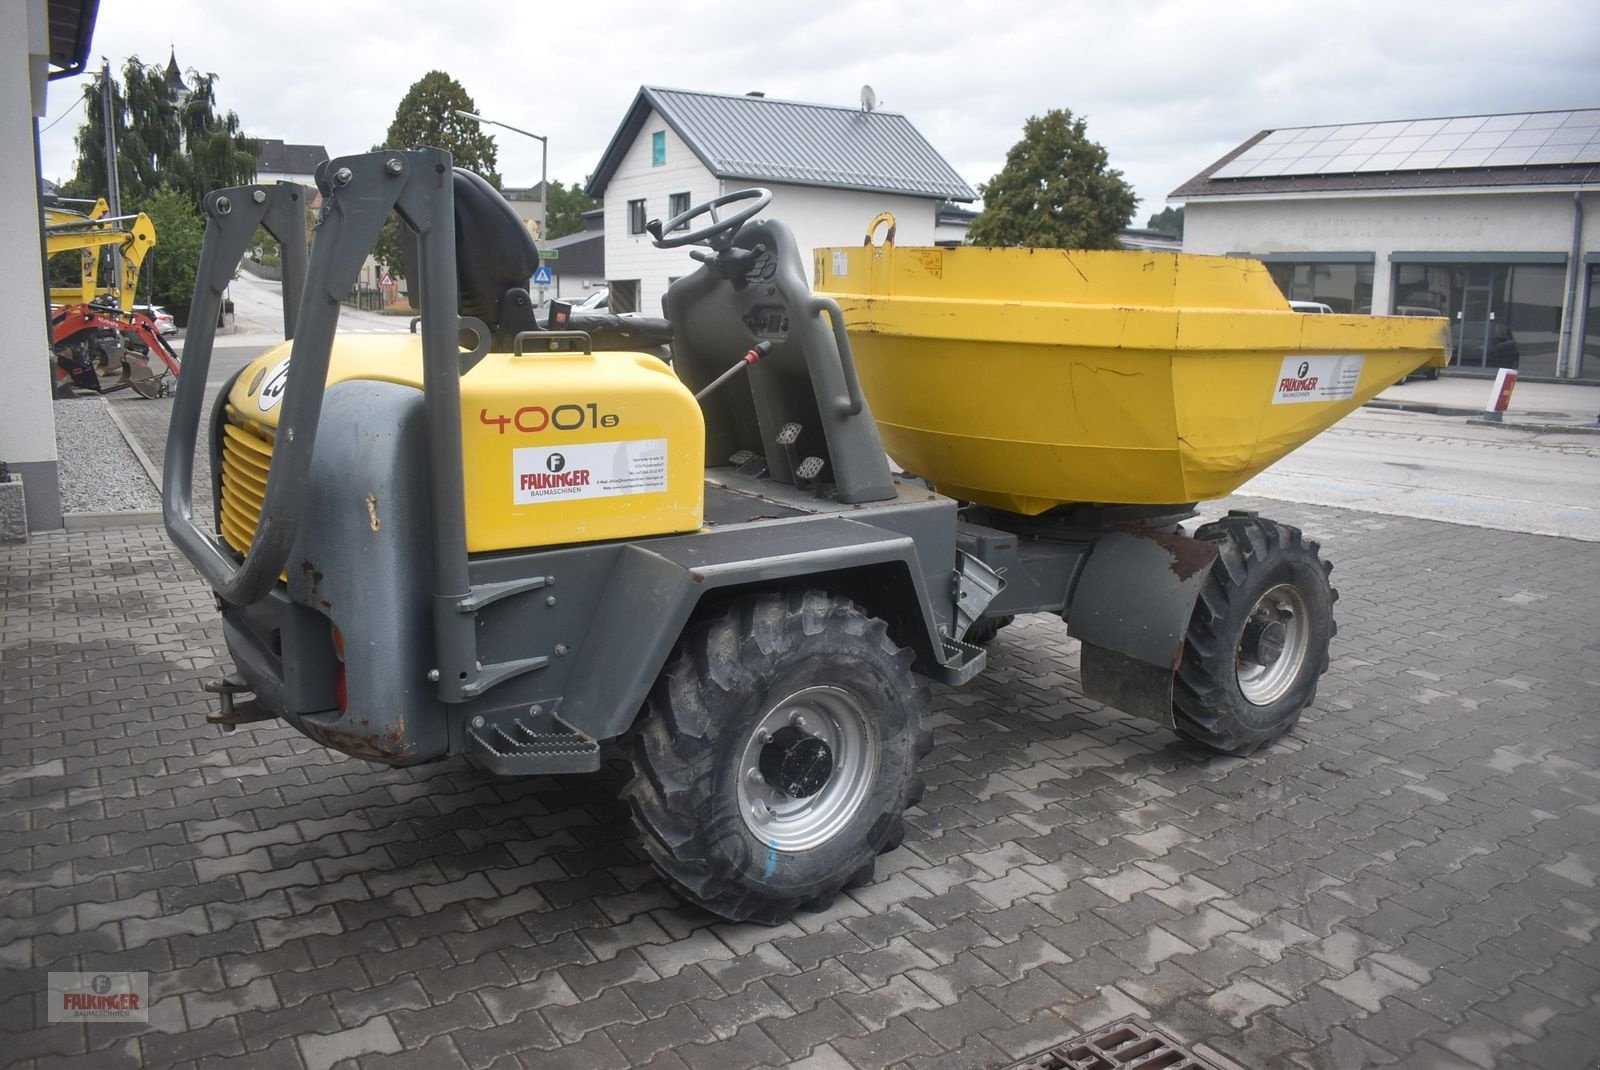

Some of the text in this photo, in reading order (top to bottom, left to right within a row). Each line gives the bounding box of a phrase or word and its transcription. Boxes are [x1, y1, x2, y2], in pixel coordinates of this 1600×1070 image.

[1279, 377, 1318, 392] FALKINGER
[520, 470, 590, 491] FALKINGER
[530, 487, 582, 497] BAUMASCHINEN
